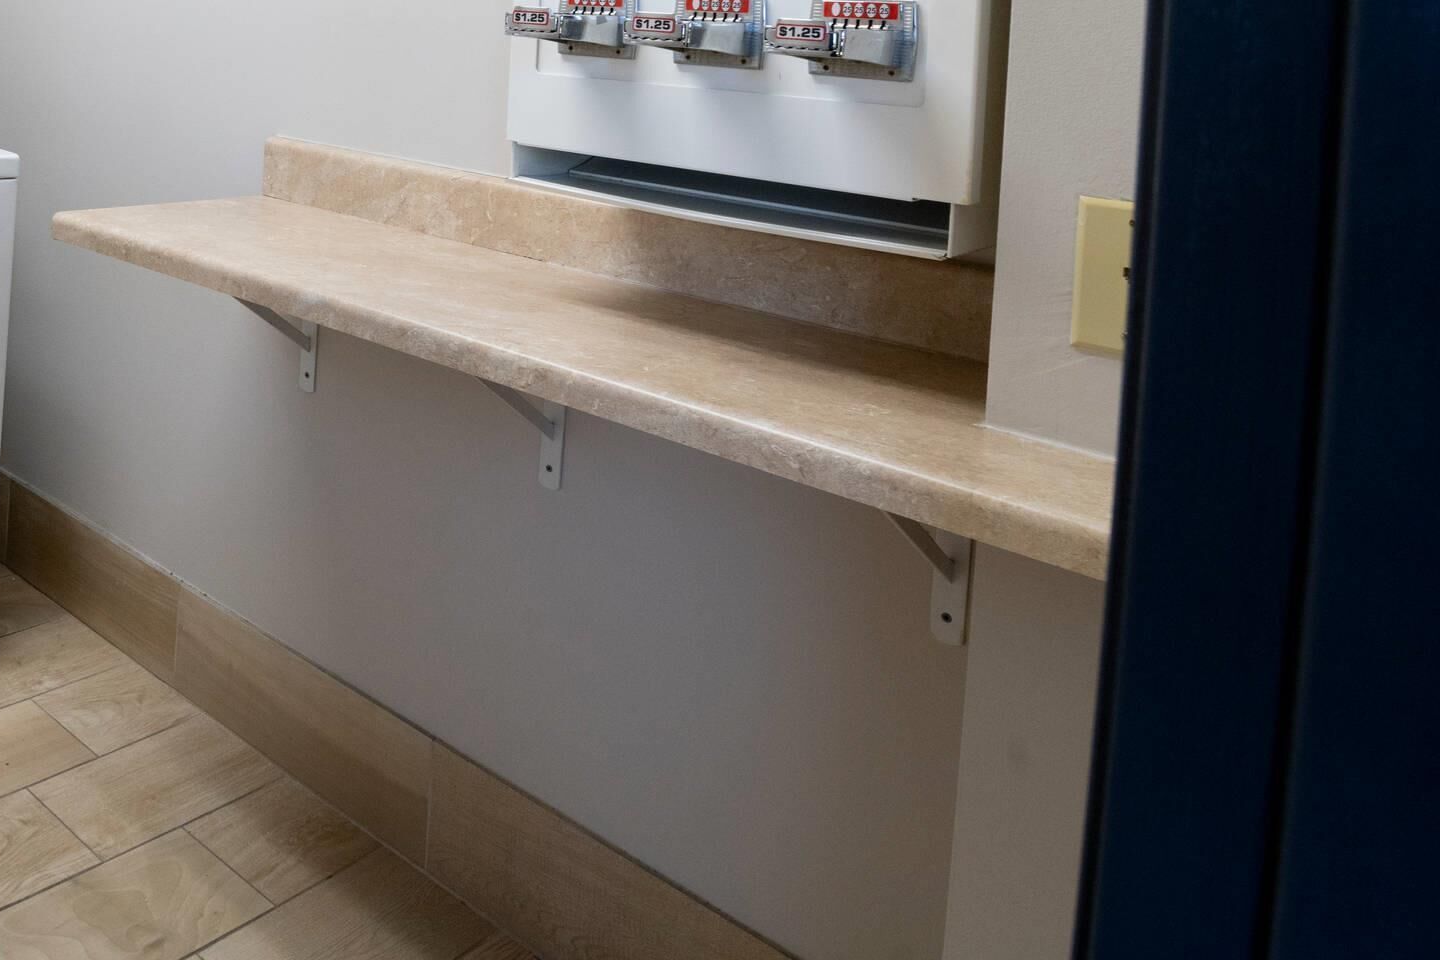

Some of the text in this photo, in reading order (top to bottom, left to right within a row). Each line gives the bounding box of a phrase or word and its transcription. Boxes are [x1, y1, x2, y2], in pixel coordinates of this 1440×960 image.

[515, 13, 545, 22] $1.25
[636, 20, 670, 30] $1.25
[778, 26, 821, 38] $1.25
